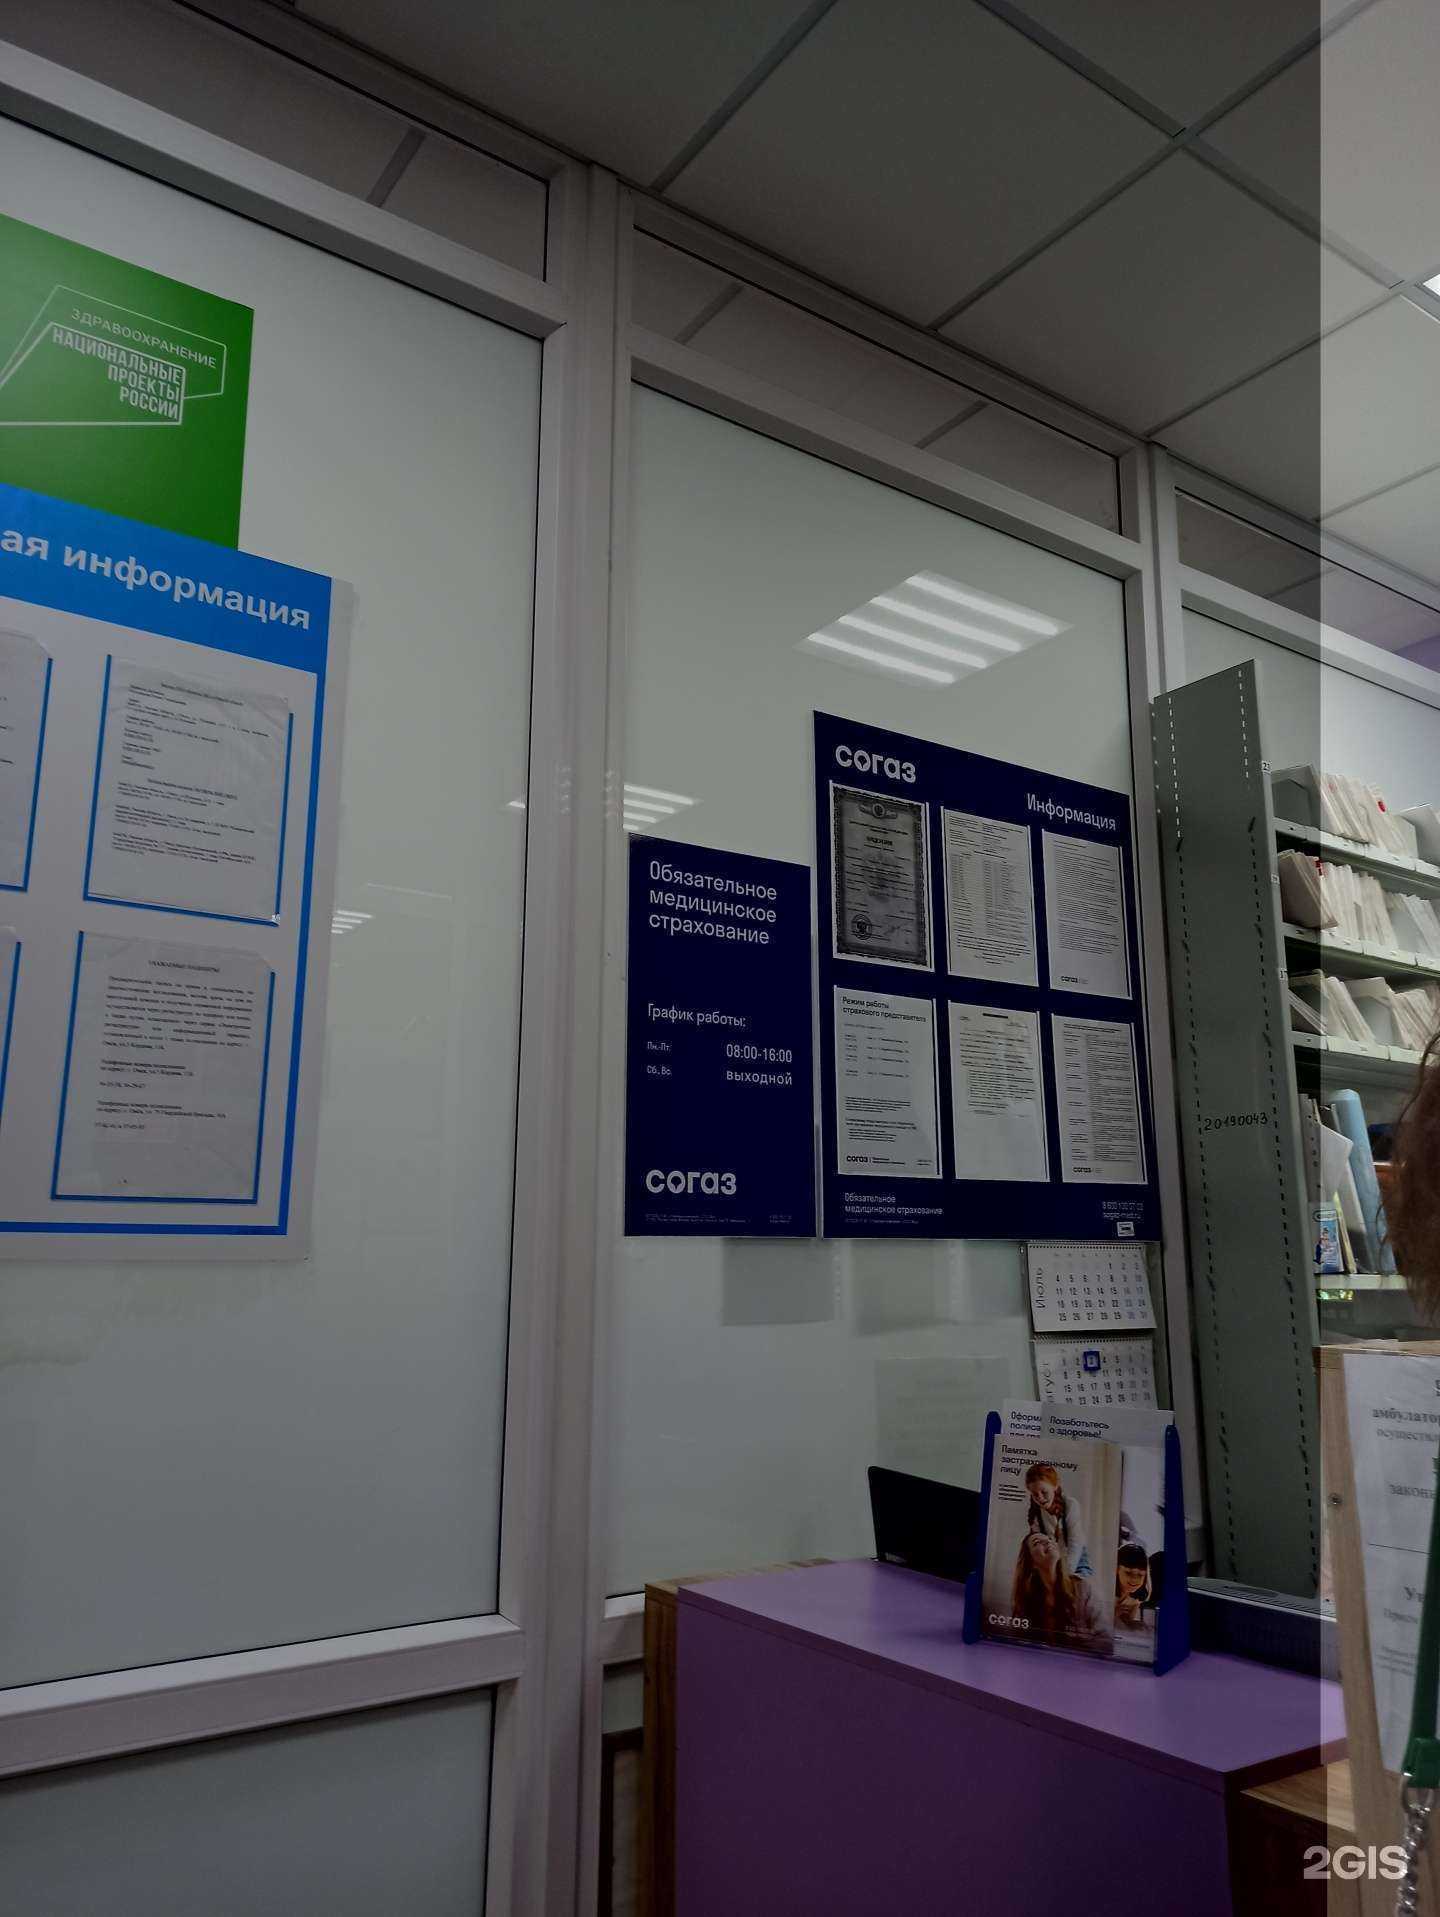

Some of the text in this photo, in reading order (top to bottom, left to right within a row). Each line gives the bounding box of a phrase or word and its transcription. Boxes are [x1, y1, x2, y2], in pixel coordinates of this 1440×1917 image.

[71, 308, 217, 369] ЗДРАВООХРАНЕНИЕ
[52, 328, 182, 385] НАЦИОНАЛЬНЫЕ
[108, 364, 180, 402] ПРОЕКТЫ
[119, 386, 178, 420] РОССИИ
[64, 545, 310, 630] информация
[835, 745, 916, 783] согаз
[1026, 793, 1117, 832] Информация
[650, 861, 777, 900] Обязательное
[650, 889, 777, 922] медицинское
[649, 914, 769, 944] страхование
[648, 1003, 746, 1028] График работы:
[726, 1043, 792, 1063] 08:00-16:00
[726, 1070, 792, 1086] выходной
[1204, 1112, 1268, 1131] 20190043
[646, 1169, 737, 1195] согаз
[1050, 1415, 1110, 1429] Позаботьтесь
[1001, 1444, 1038, 1456] Памятка
[1000, 1466, 1021, 1477] лицу
